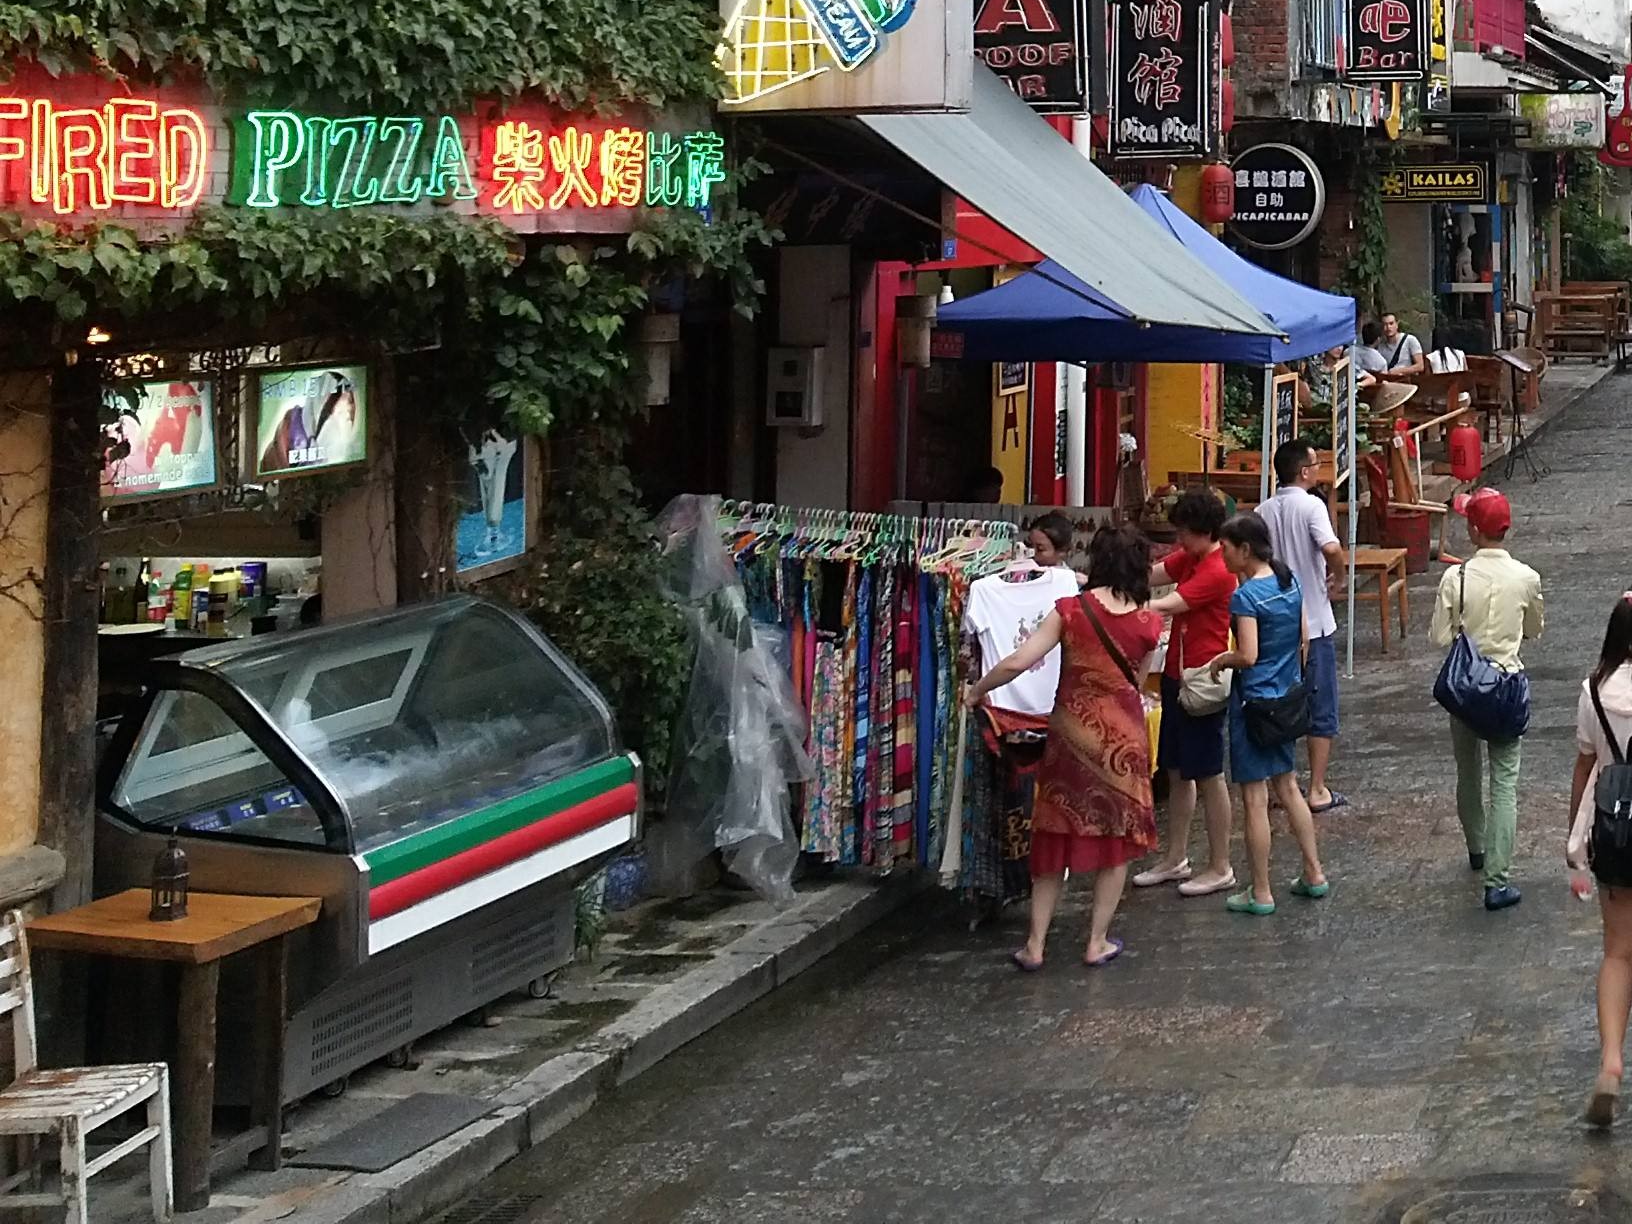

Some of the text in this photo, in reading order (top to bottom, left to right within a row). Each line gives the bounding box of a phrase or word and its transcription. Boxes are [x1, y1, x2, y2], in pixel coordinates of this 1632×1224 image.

[1357, 46, 1414, 69] Bar
[247, 110, 478, 210] PIZZA
[492, 122, 727, 215] 柴火烤比萨
[1412, 172, 1475, 187] KAILAS
[1255, 192, 1284, 207] 自助
